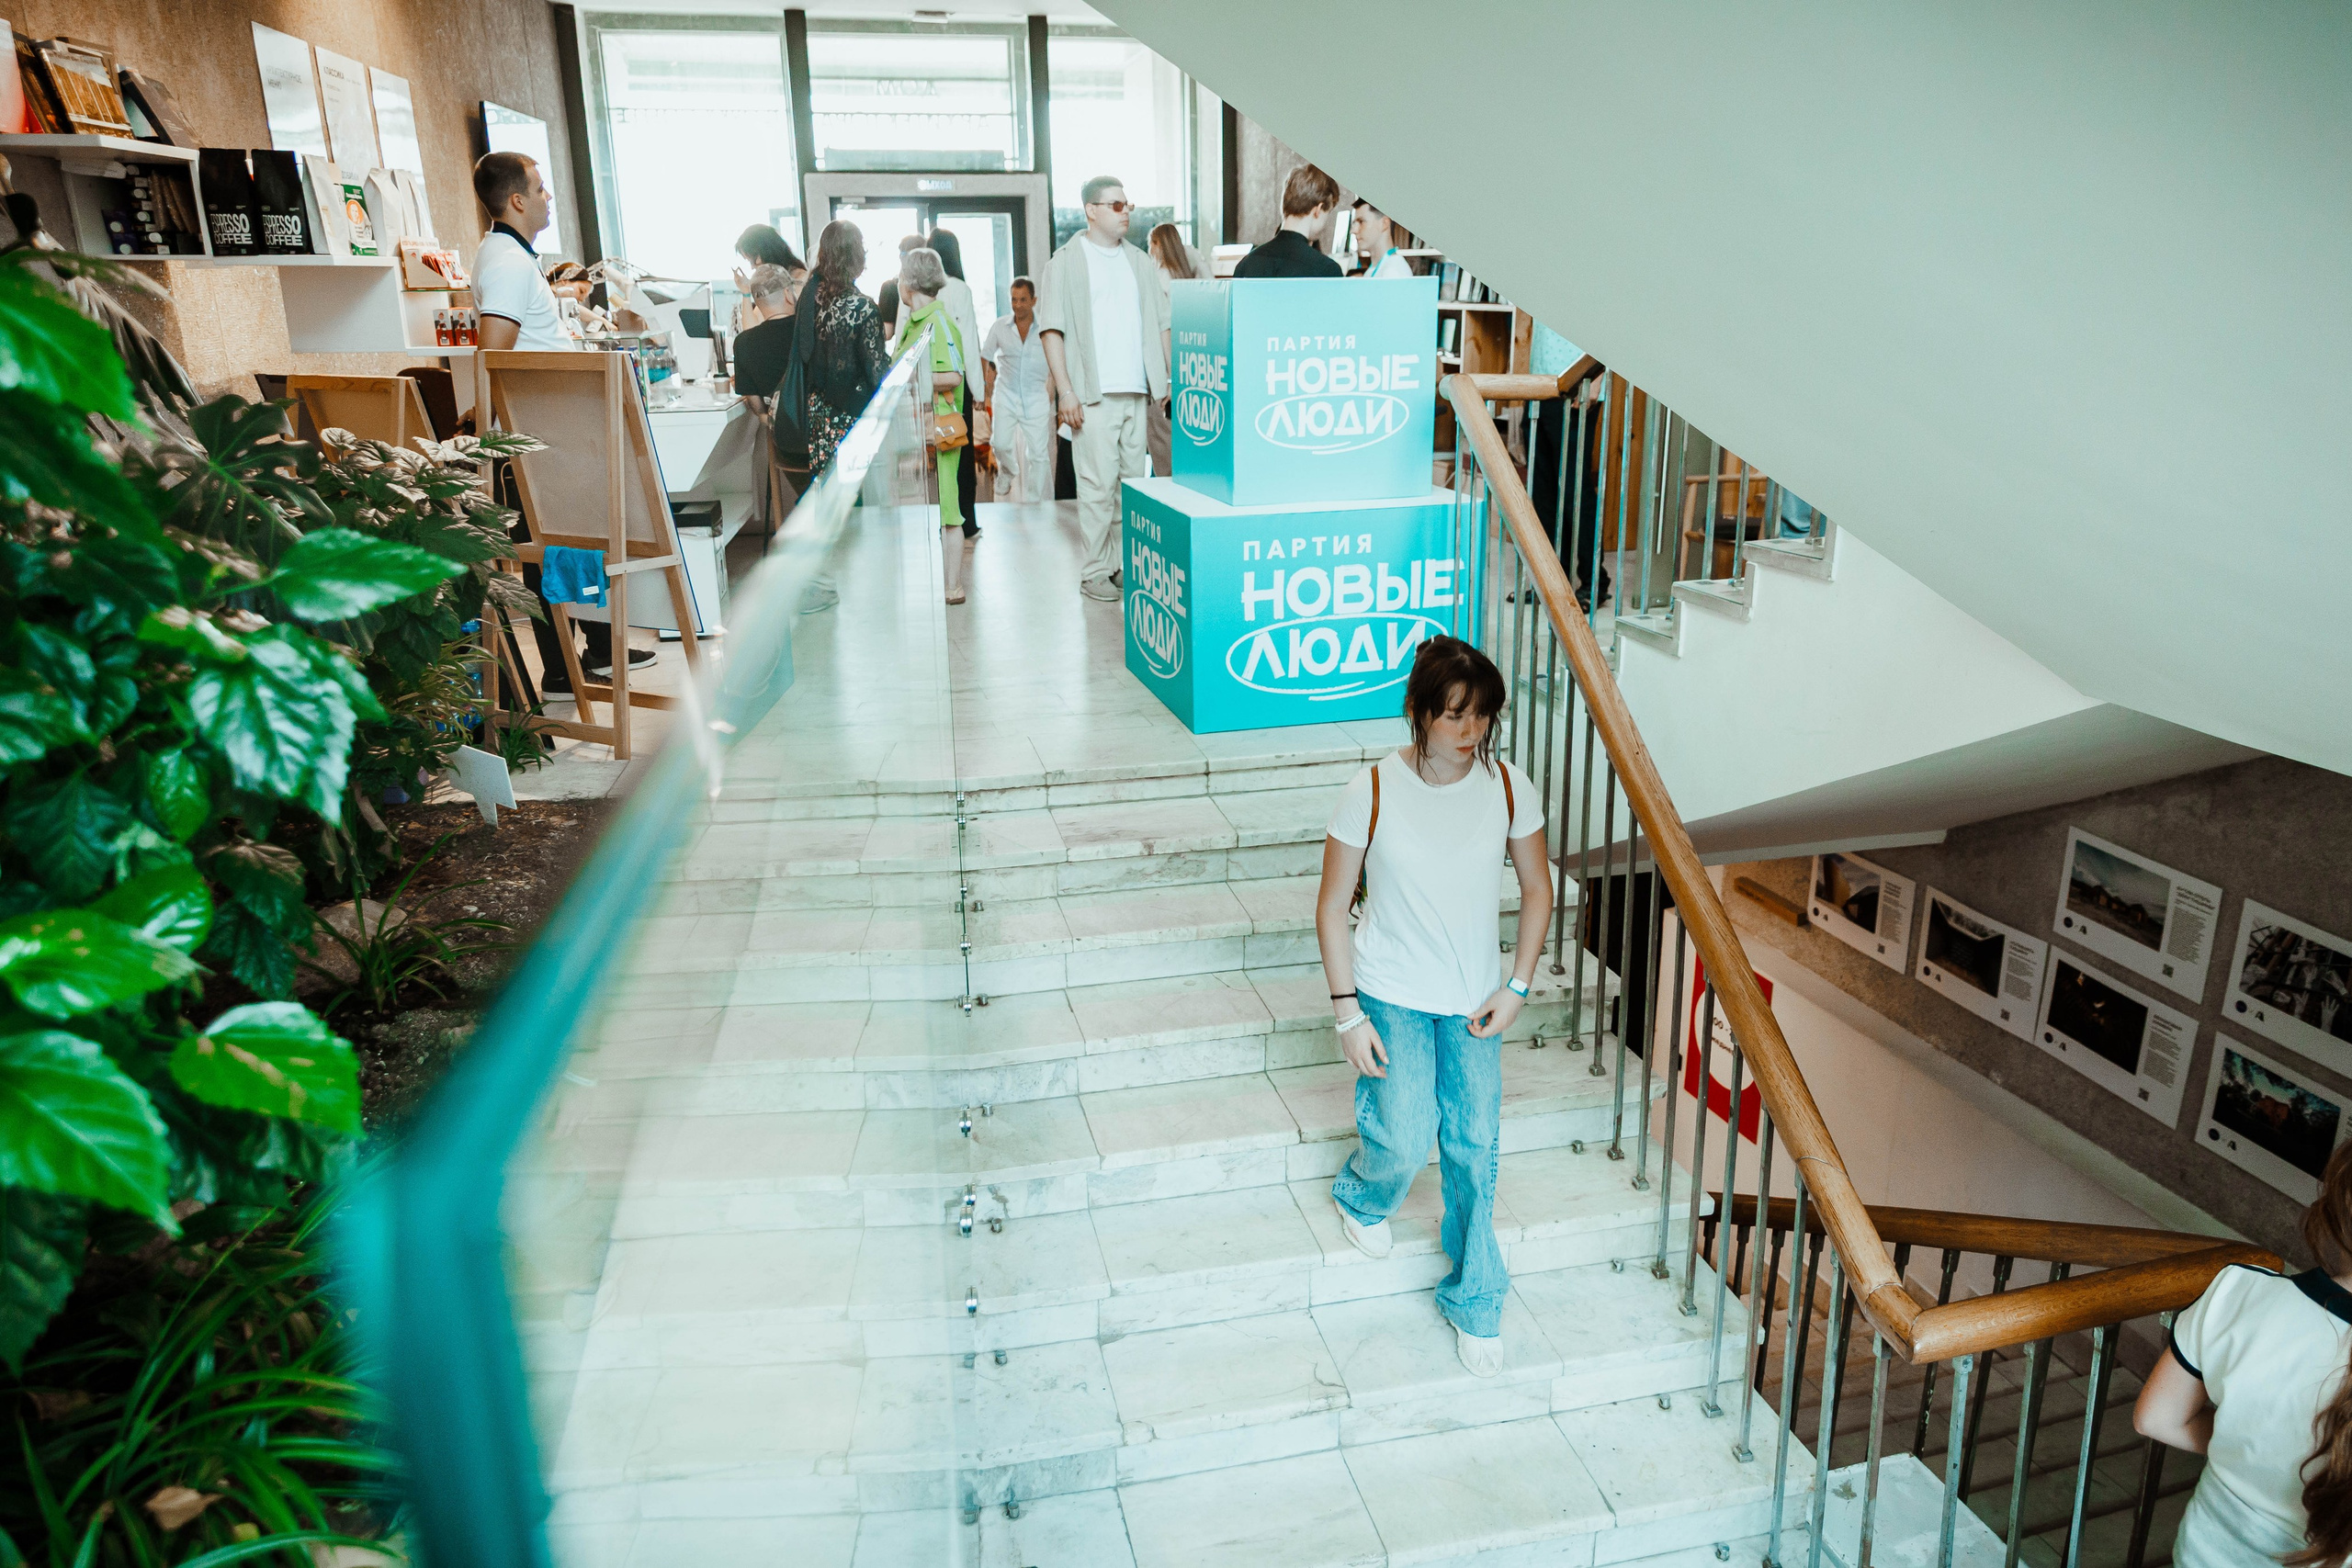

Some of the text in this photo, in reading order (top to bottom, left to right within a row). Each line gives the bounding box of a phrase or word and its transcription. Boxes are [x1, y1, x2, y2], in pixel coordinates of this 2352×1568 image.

[210, 213, 250, 233] ESPRESSO
[214, 233, 253, 244] COFFEE
[262, 214, 301, 234] ESPRESSO
[266, 234, 303, 246] COFFEE
[1179, 331, 1207, 346] ПАРТИЯ
[1267, 334, 1356, 352] ПАРТИЯ
[1179, 351, 1228, 392] НОВЫЕ
[1265, 355, 1419, 395] НОВЫЕ
[1178, 393, 1220, 434] ЛЮДИ
[1266, 400, 1394, 438] ЛЮДИ
[1131, 510, 1161, 544] ПАРТИЯ
[1243, 534, 1373, 561] ПАРТИЯ
[1131, 536, 1186, 618] НОВЫЕ
[1241, 558, 1465, 621] НОВЫЕ
[1133, 600, 1178, 671] ЛЮДИ
[1241, 620, 1426, 682] ЛЮДИ
